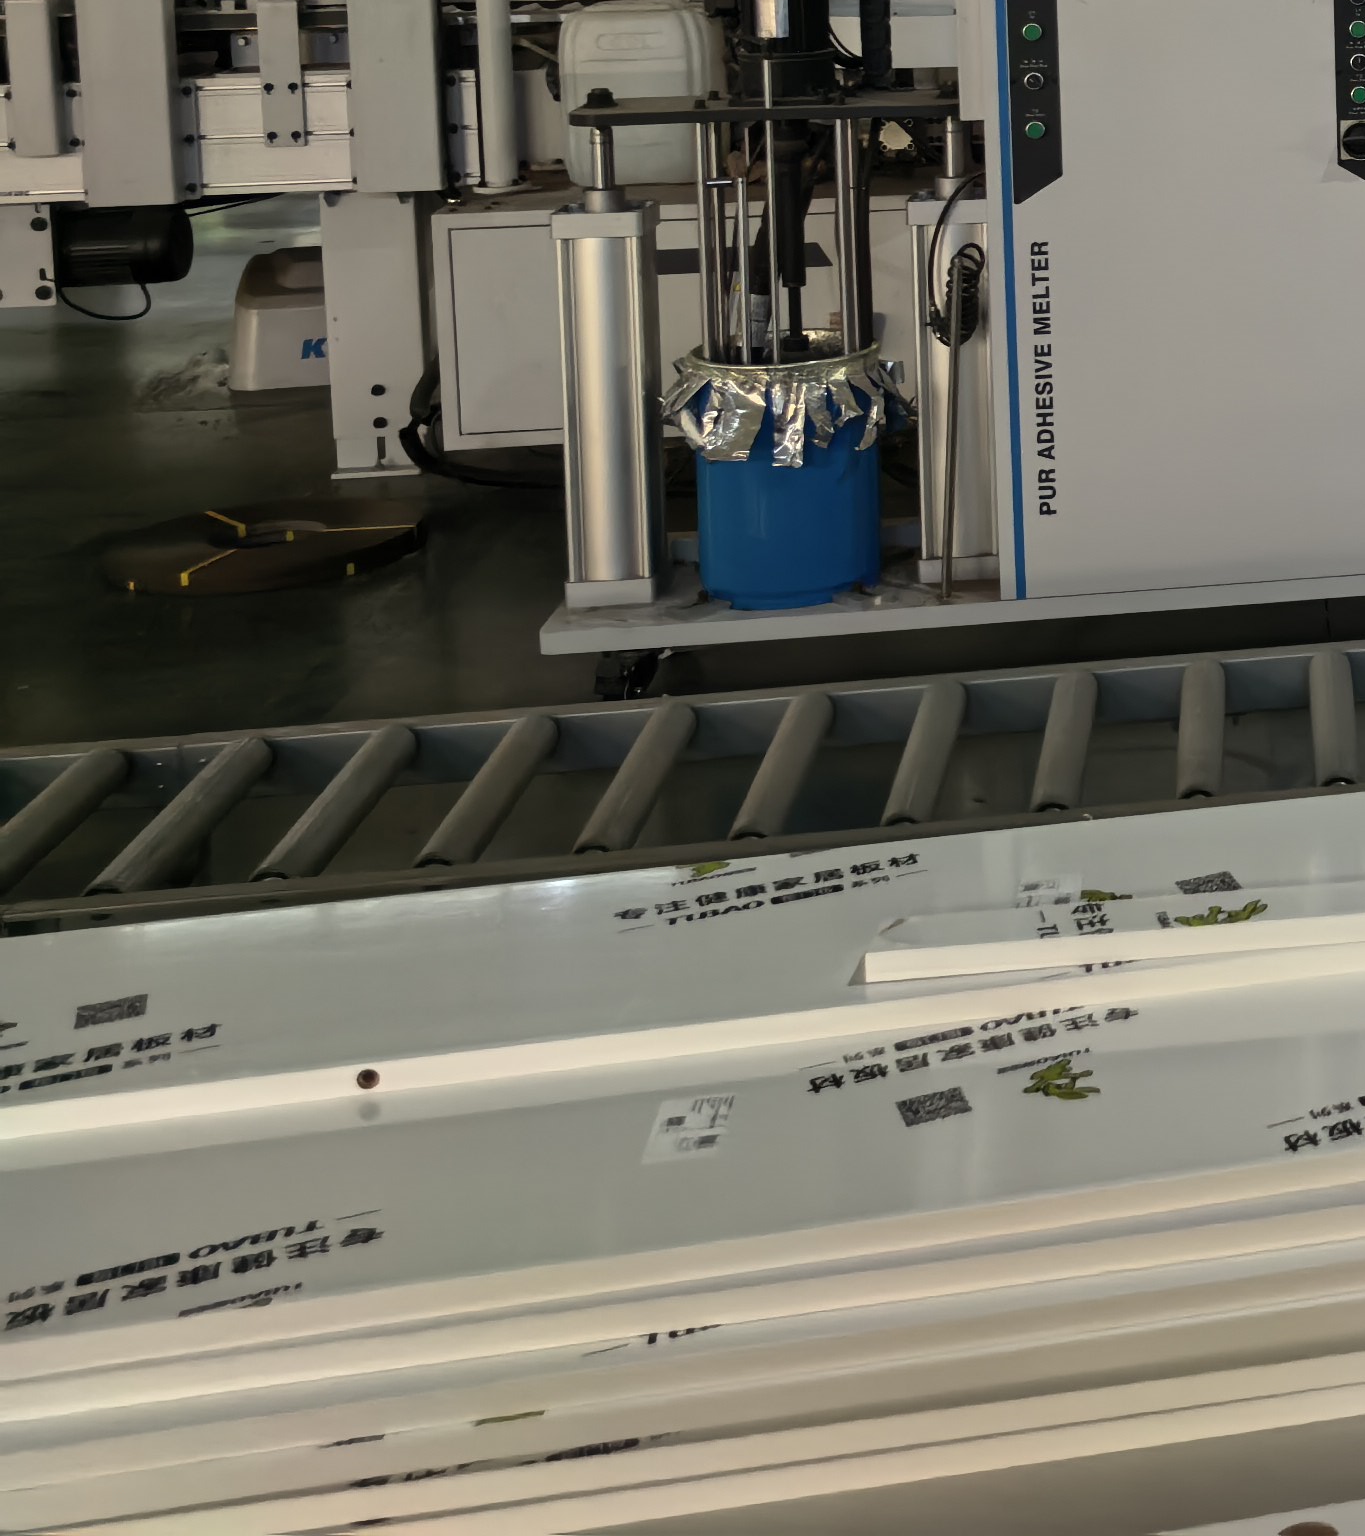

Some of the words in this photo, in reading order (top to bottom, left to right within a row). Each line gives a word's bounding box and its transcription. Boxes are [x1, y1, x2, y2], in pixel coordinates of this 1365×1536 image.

[1030, 241, 1051, 335] MELTER
[1034, 343, 1056, 461] ADHESIVE
[1038, 468, 1057, 516] PUR
